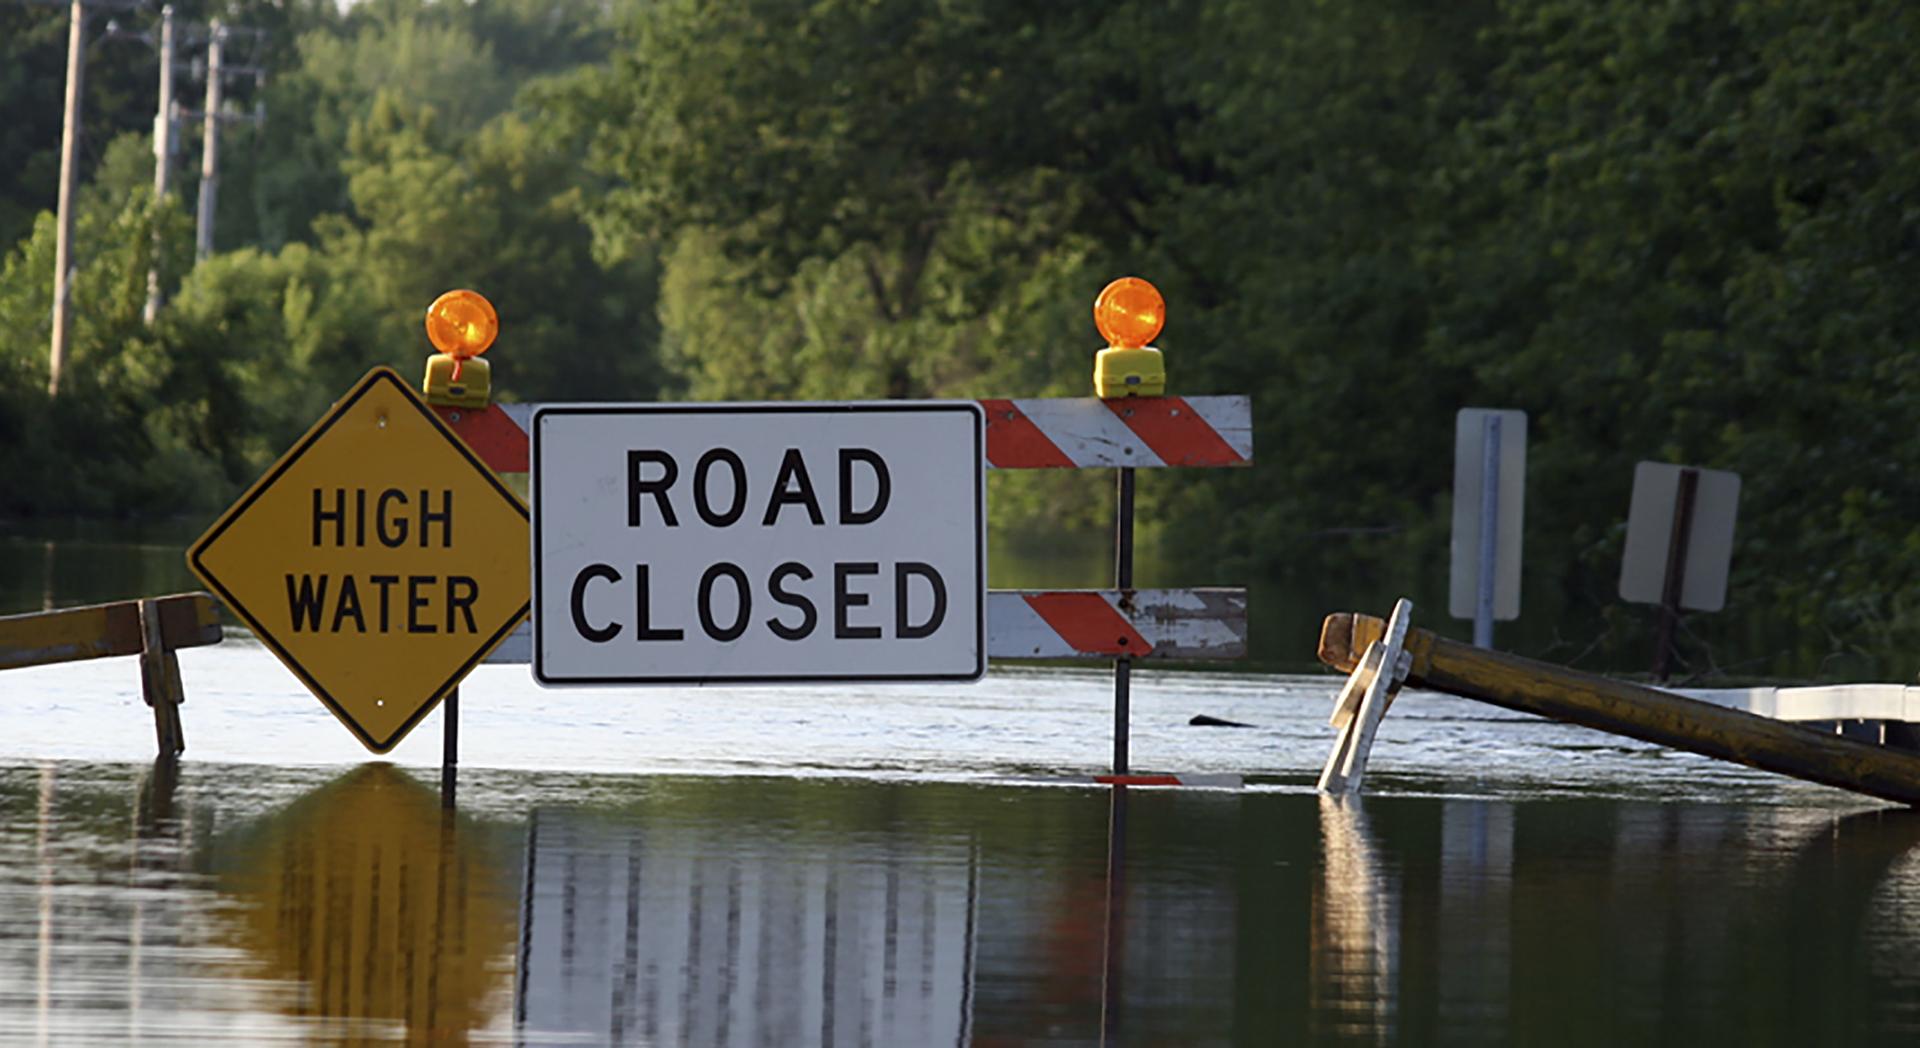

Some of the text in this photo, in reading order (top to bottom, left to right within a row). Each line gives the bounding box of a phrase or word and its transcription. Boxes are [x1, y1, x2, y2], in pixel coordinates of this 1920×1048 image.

[311, 487, 453, 550] HIGH
[627, 448, 892, 528] ROAD
[284, 572, 480, 635] WATER
[570, 562, 948, 643] CLOSED
